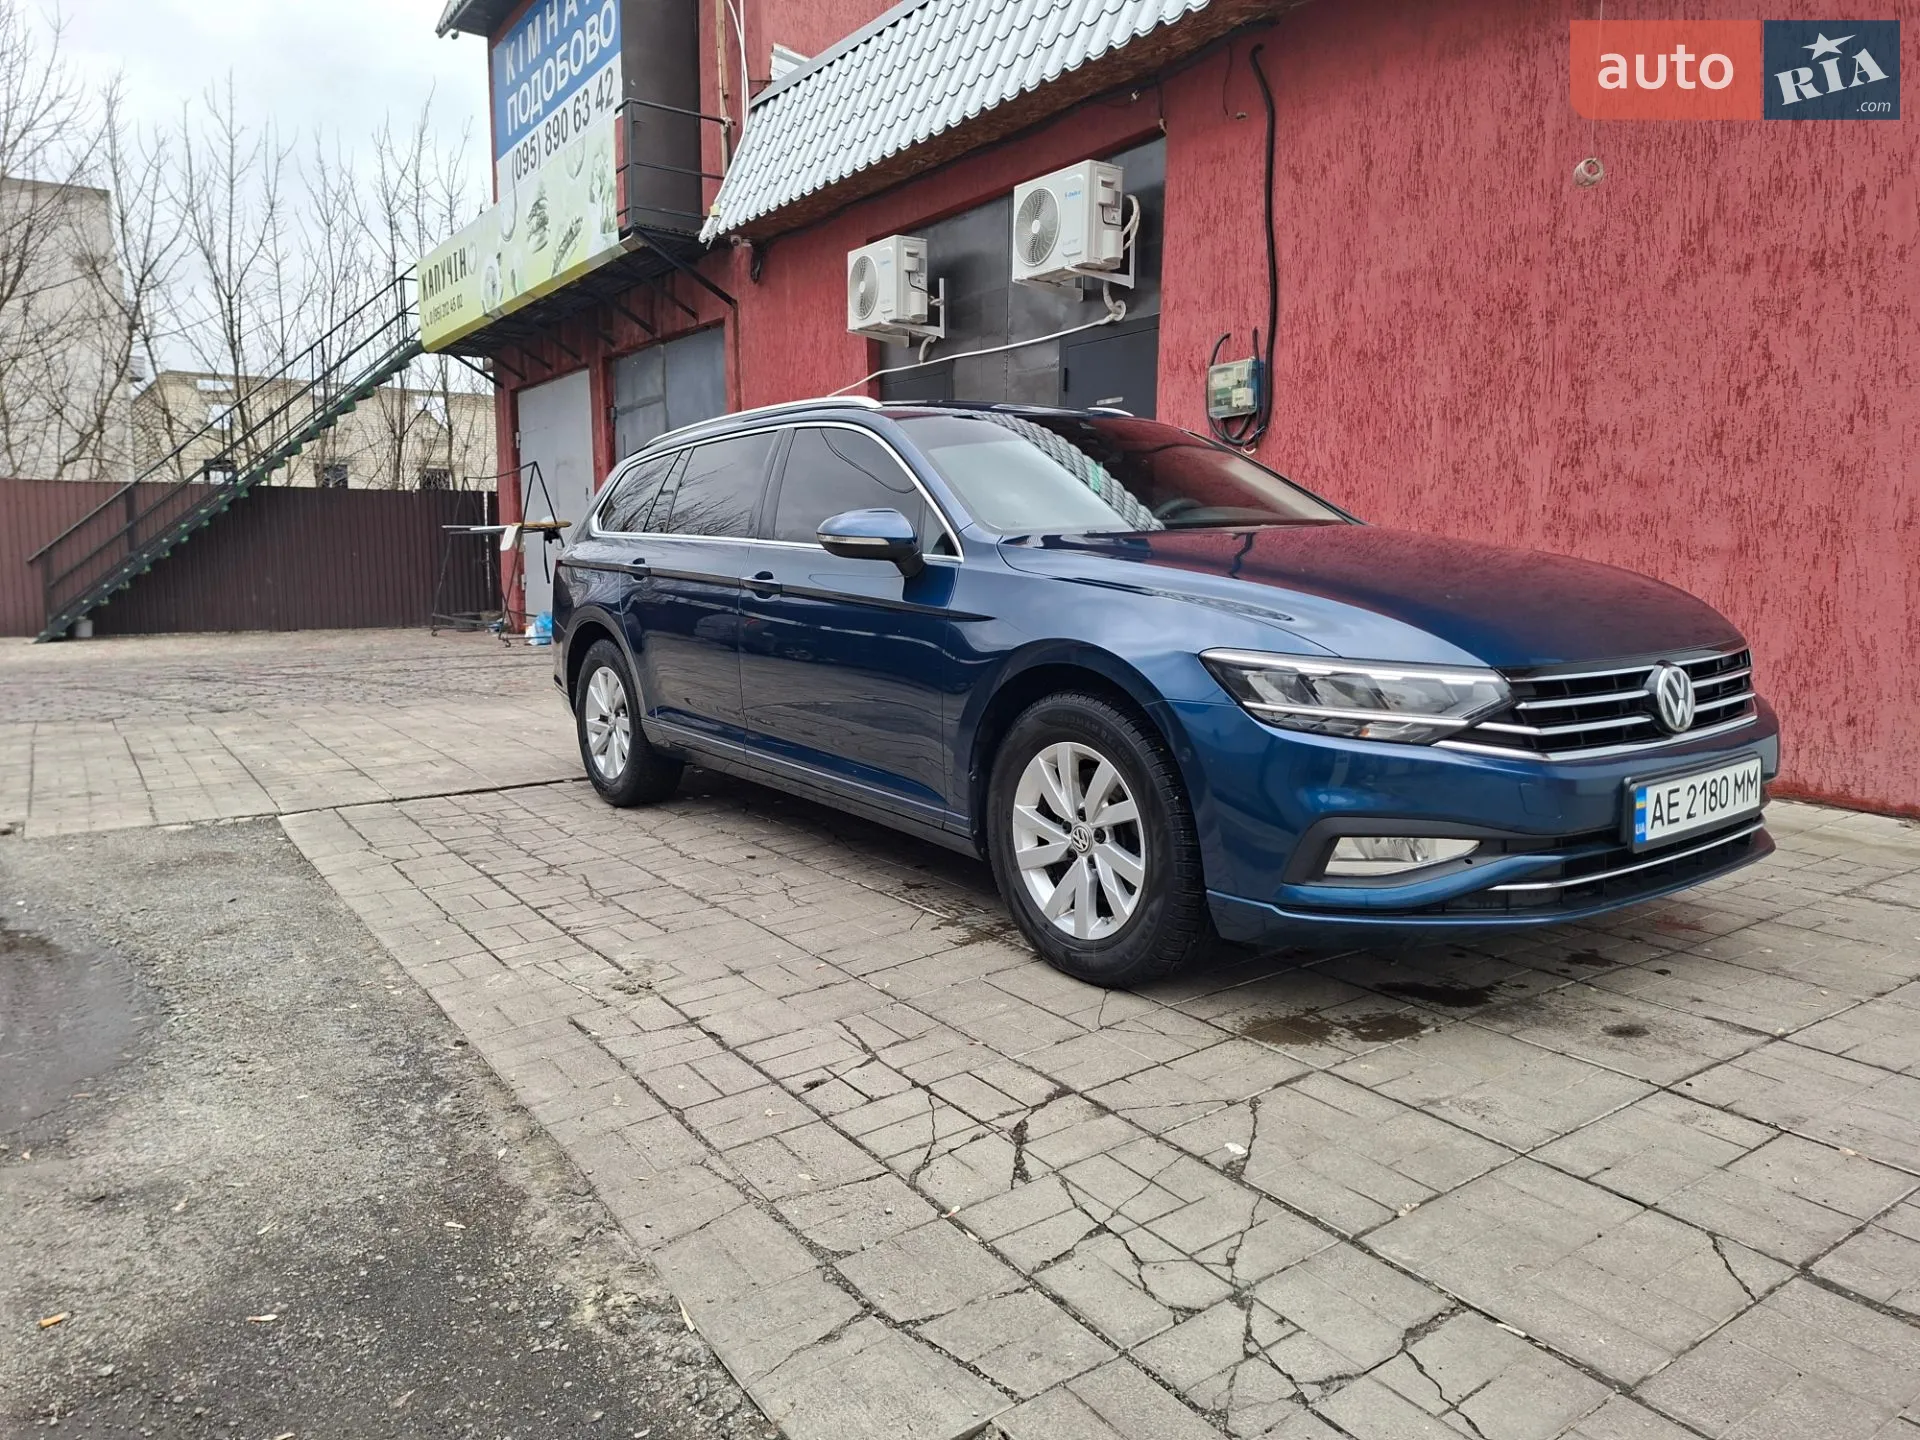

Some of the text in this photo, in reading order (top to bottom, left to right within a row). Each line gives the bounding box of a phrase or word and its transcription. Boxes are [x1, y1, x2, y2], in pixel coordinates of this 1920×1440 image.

[506, 0, 589, 86] КІМНА
[507, 0, 616, 136] ПОДОБОВО
[511, 67, 614, 190] (095) 890 63 42
[1650, 766, 1759, 830] AE 2180 MM
